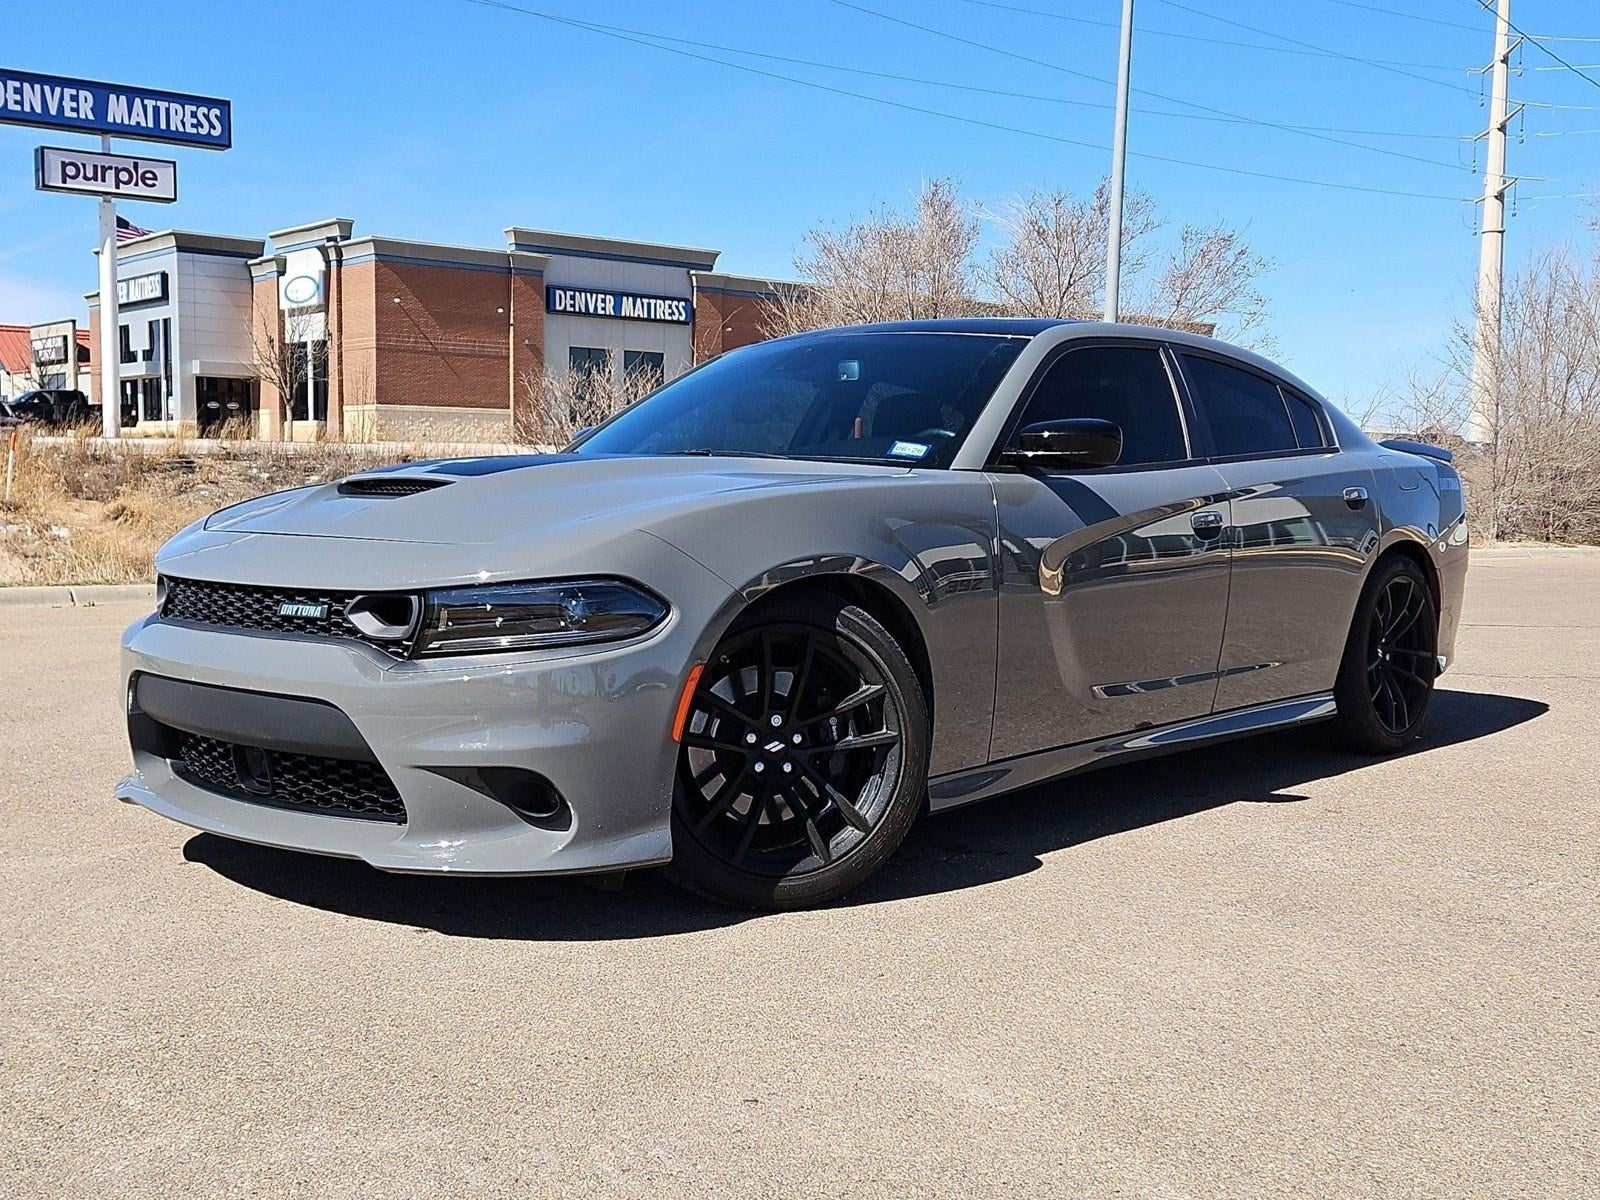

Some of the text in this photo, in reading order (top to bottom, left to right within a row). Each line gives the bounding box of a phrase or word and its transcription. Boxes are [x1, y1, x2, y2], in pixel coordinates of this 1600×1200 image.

[107, 93, 223, 137] MATTRESS
[60, 159, 158, 189] purple
[555, 289, 686, 321] DENVER MATTRESS
[280, 604, 322, 618] DAYTONA
